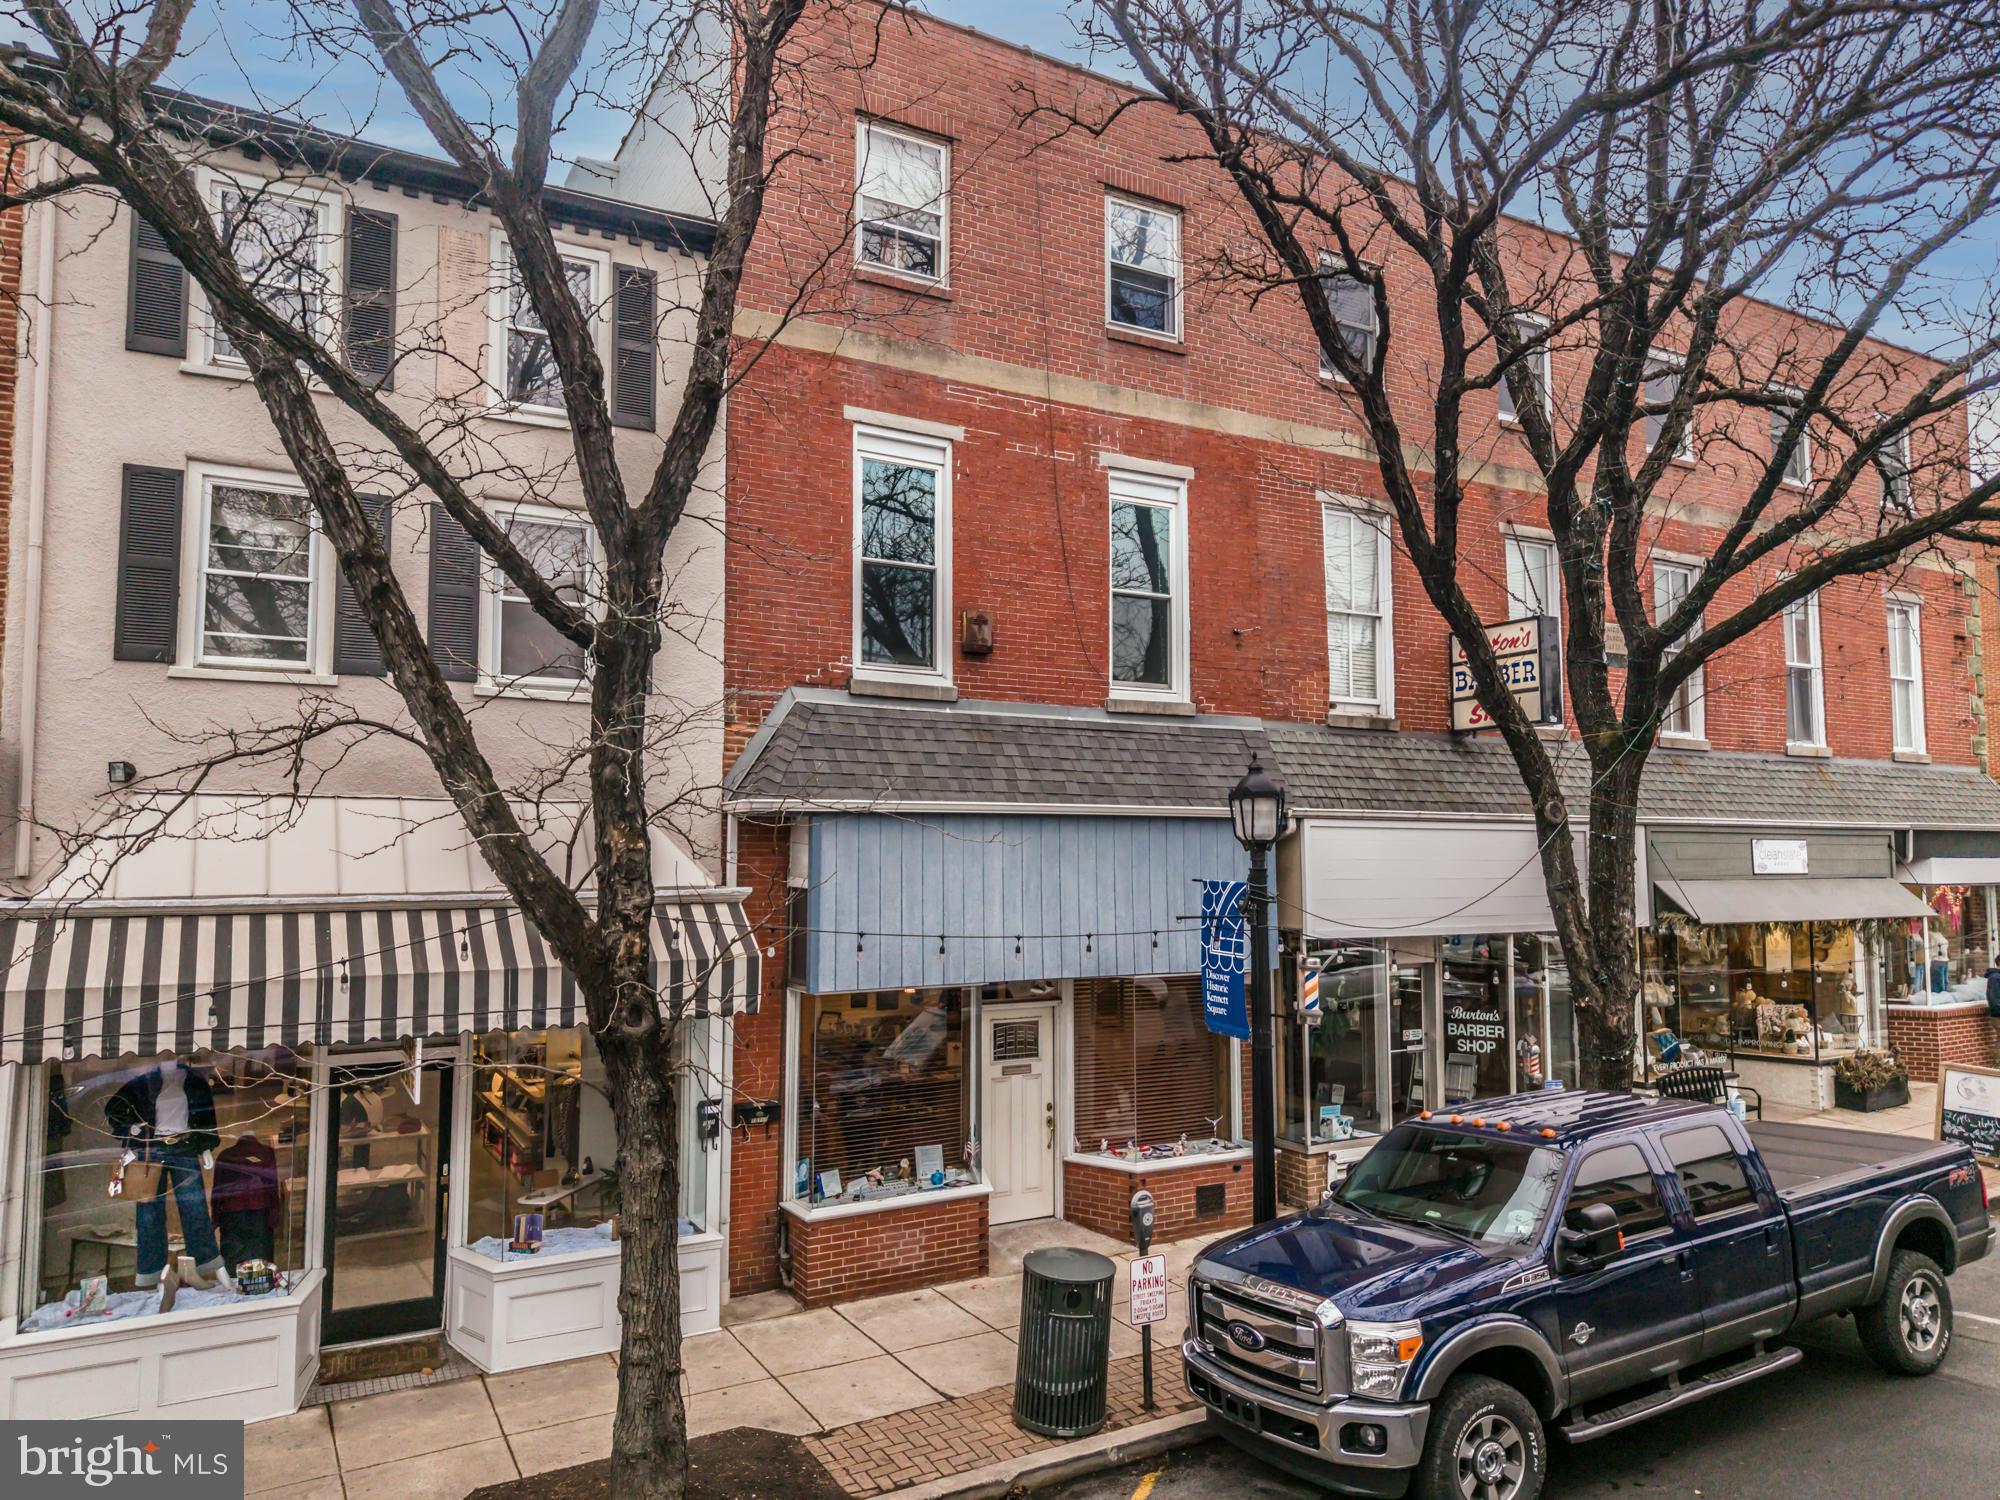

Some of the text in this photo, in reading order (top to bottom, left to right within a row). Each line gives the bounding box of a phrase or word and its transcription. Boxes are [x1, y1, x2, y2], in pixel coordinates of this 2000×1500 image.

[1206, 968, 1230, 982] Discover
[1206, 980, 1229, 993] Historic
[1206, 991, 1229, 1005] Kennett
[1206, 1002, 1227, 1016] Square
[1451, 1006, 1500, 1021] Burton's
[1447, 1022, 1505, 1039] BARBER
[1457, 1039, 1497, 1053] SHOP
[1738, 1038, 1783, 1049] IMPROVING
[1653, 1063, 1669, 1072] EVERY
[1669, 1059, 1694, 1070] PRODUCT
[1695, 1058, 1705, 1067] HAS
[1142, 1261, 1153, 1275] NO
[1132, 1274, 1164, 1292] PARKING
[1233, 1325, 1253, 1346] Ford
[1453, 1403, 1495, 1457] DISCOVERER
